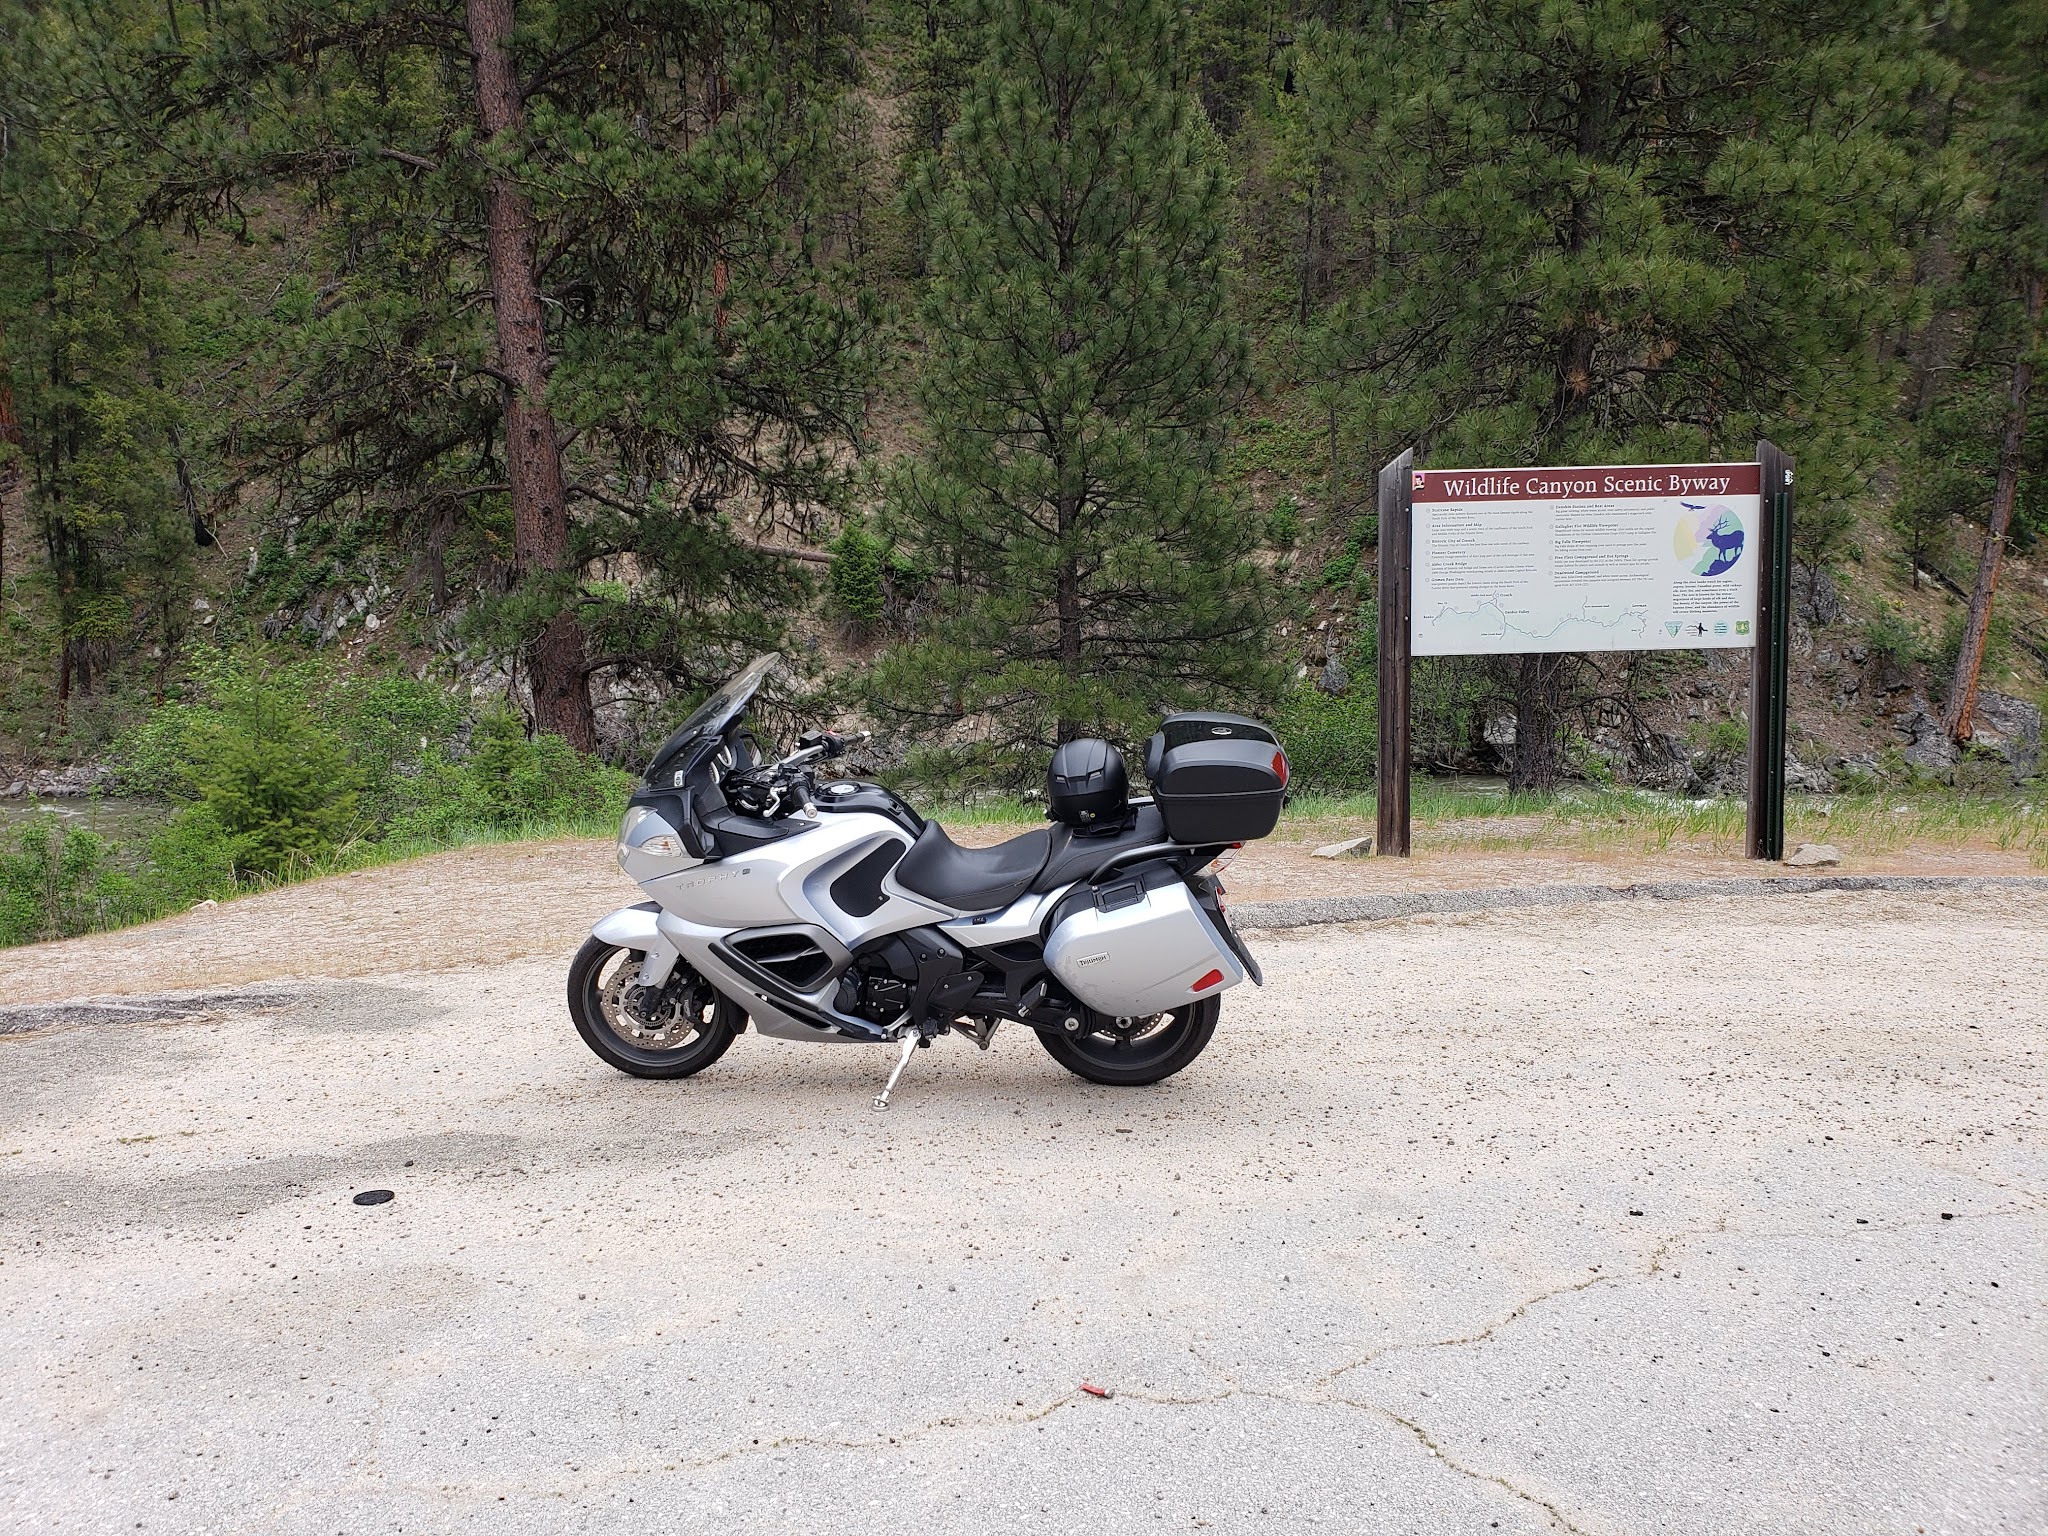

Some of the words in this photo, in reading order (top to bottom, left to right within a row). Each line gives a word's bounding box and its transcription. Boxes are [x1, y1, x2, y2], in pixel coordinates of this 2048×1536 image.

[1444, 477, 1519, 496] Wildlife
[1526, 478, 1597, 498] Canyon
[1605, 477, 1662, 492] Scenic
[1669, 475, 1730, 495] Byway
[676, 870, 739, 890] TROPHY
[1079, 955, 1107, 966] TRIUMPH
